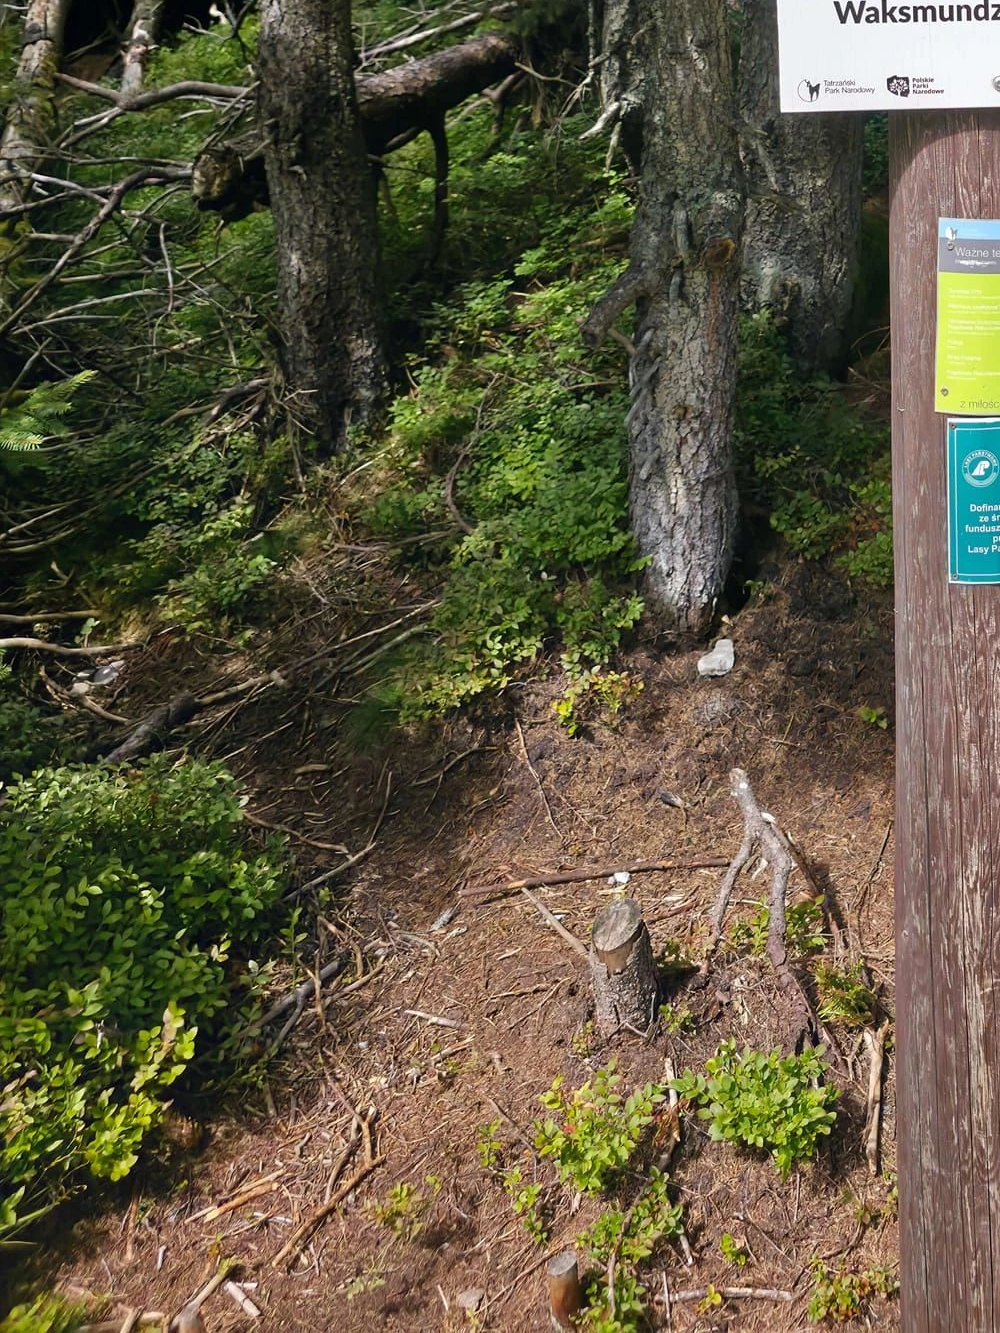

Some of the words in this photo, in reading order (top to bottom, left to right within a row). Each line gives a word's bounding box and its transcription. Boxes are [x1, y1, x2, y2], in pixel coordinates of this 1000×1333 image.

[824, 79, 856, 87] Tatrzański
[841, 86, 876, 95] Narodowy
[955, 247, 989, 258] Ważne
[967, 545, 990, 554] Lasy
